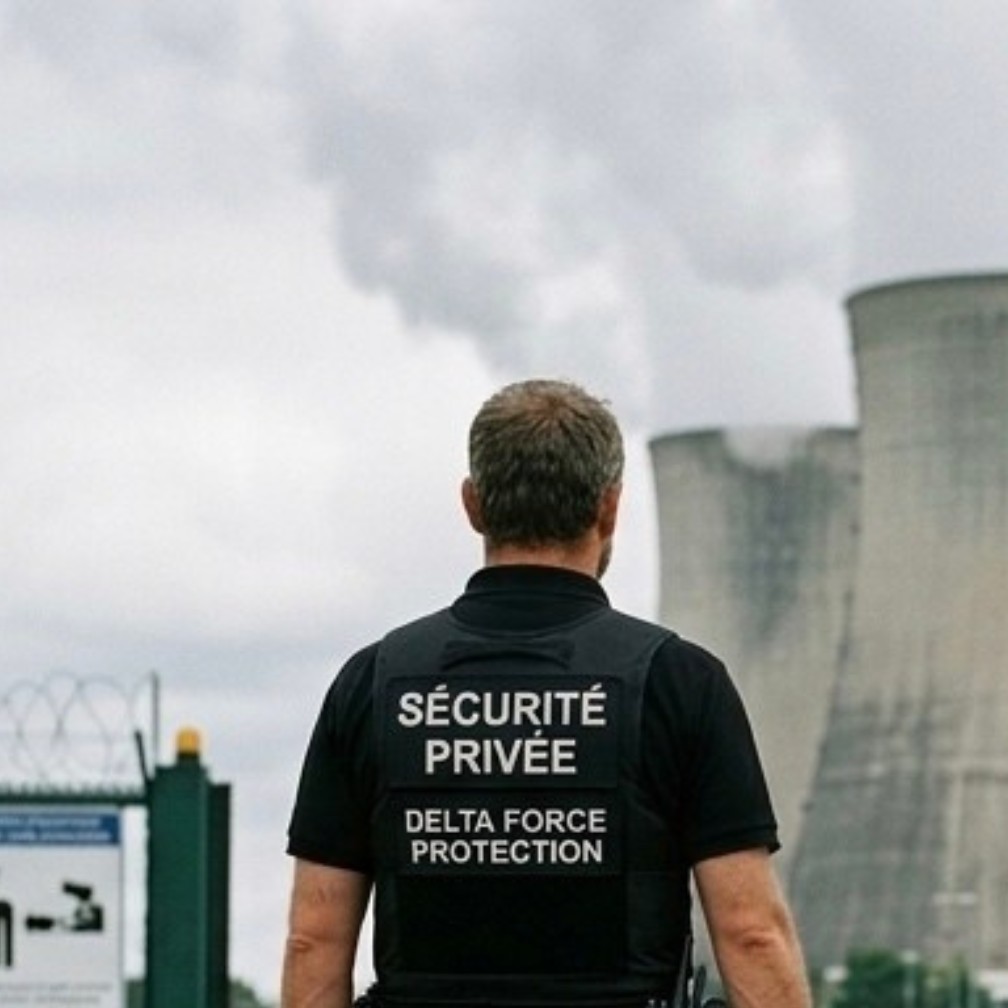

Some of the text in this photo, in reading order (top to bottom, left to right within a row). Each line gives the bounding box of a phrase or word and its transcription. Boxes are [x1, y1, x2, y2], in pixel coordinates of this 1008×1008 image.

[397, 682, 607, 727] SÉCURITÉ
[425, 729, 577, 774] PRIVÉE
[405, 808, 606, 833] DELTA FORCE
[411, 839, 602, 864] PROTECTION
